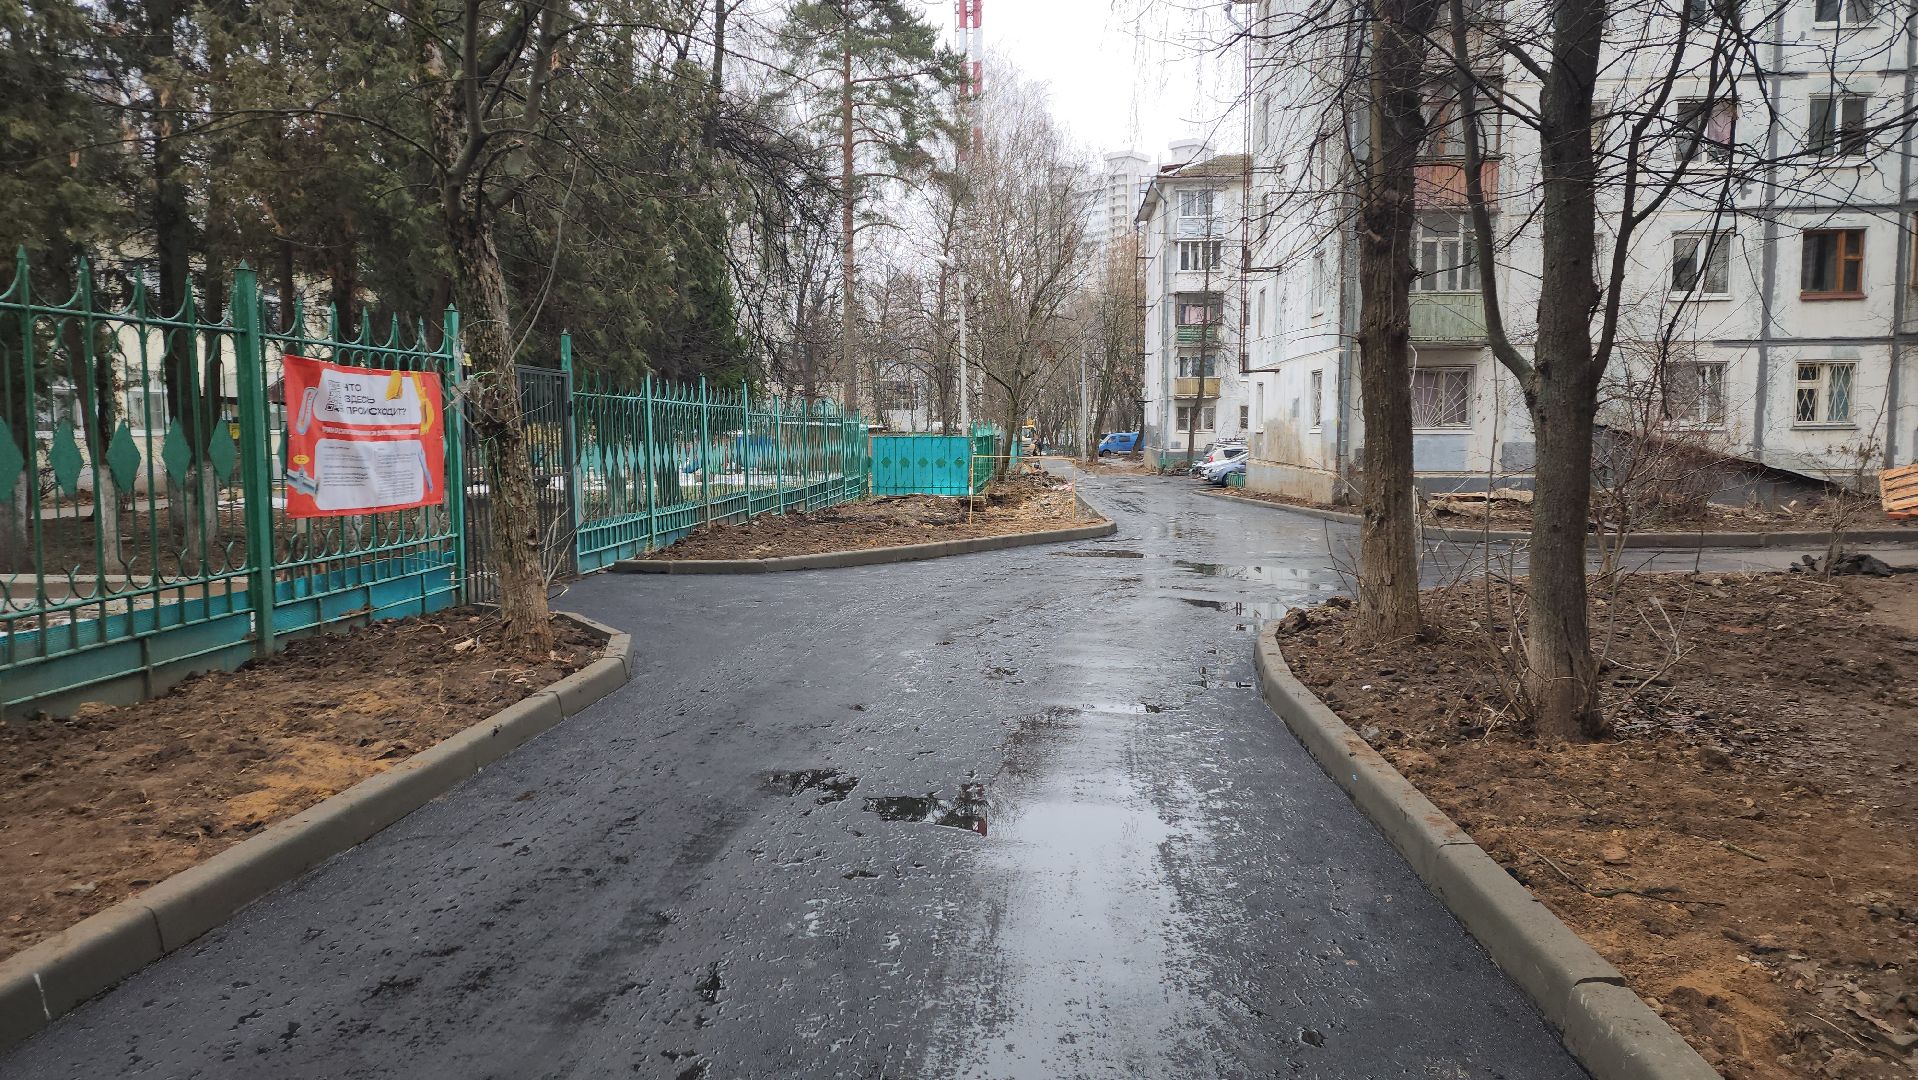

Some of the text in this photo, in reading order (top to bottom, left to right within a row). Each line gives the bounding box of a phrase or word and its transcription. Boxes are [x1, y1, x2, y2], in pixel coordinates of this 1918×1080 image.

[344, 383, 362, 392] ЧТО
[345, 395, 376, 404] ЗДЕСЬ
[346, 406, 407, 417] ПРОИСХОДИТ?
